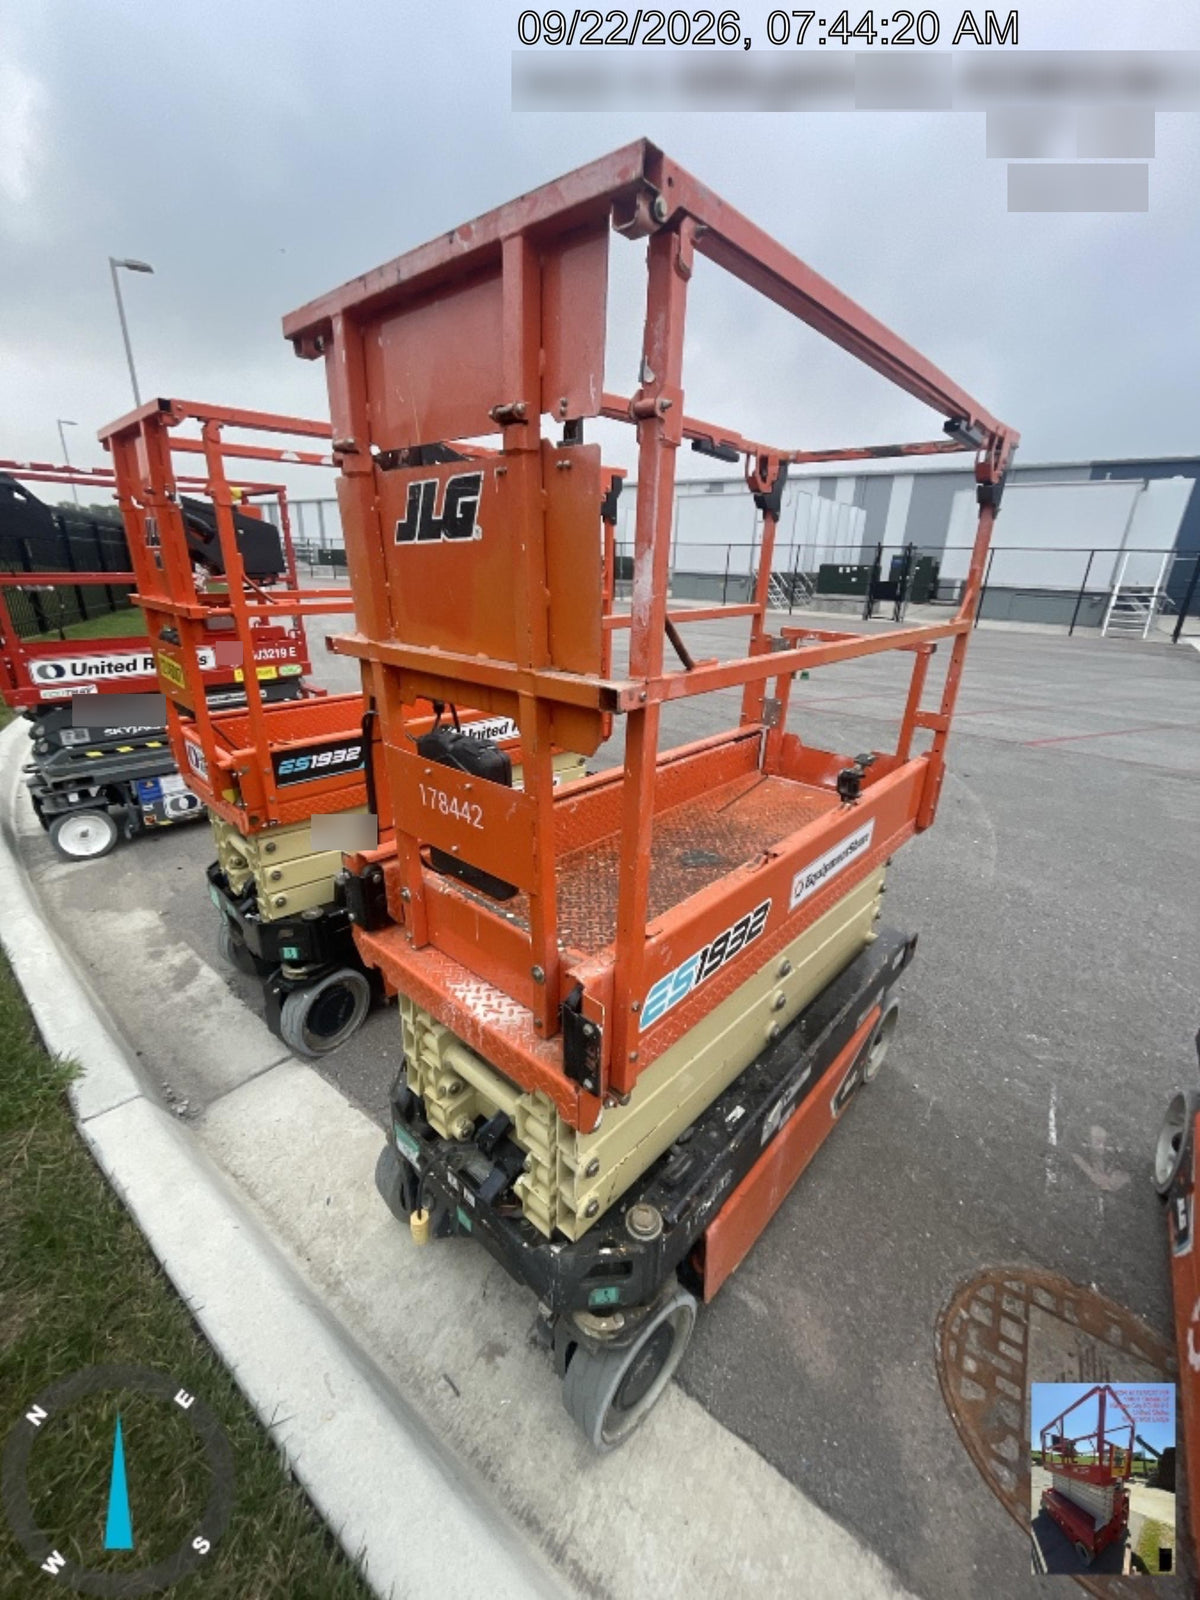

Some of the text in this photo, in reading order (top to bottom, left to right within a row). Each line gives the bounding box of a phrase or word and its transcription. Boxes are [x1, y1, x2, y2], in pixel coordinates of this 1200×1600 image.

[394, 470, 484, 545] JLG
[71, 658, 137, 677] United
[278, 745, 362, 776] ES1932
[419, 783, 484, 830] 178442
[639, 899, 772, 1033] ES1932
